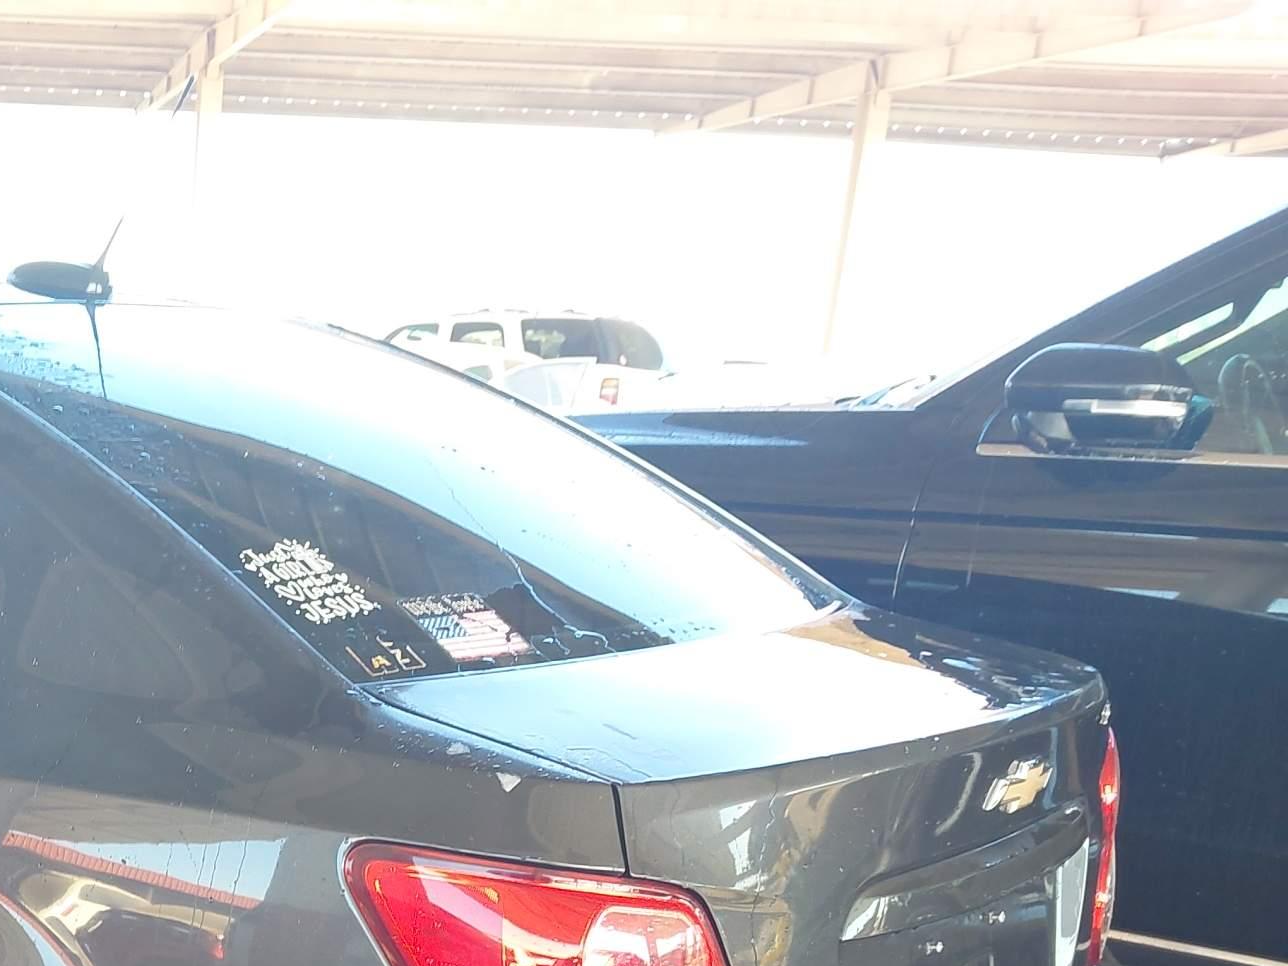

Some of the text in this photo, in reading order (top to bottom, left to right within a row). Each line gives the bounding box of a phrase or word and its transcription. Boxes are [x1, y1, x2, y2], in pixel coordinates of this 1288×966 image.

[242, 542, 292, 572] Just
[259, 559, 316, 584] A GIRL
[300, 591, 375, 622] JESUS
